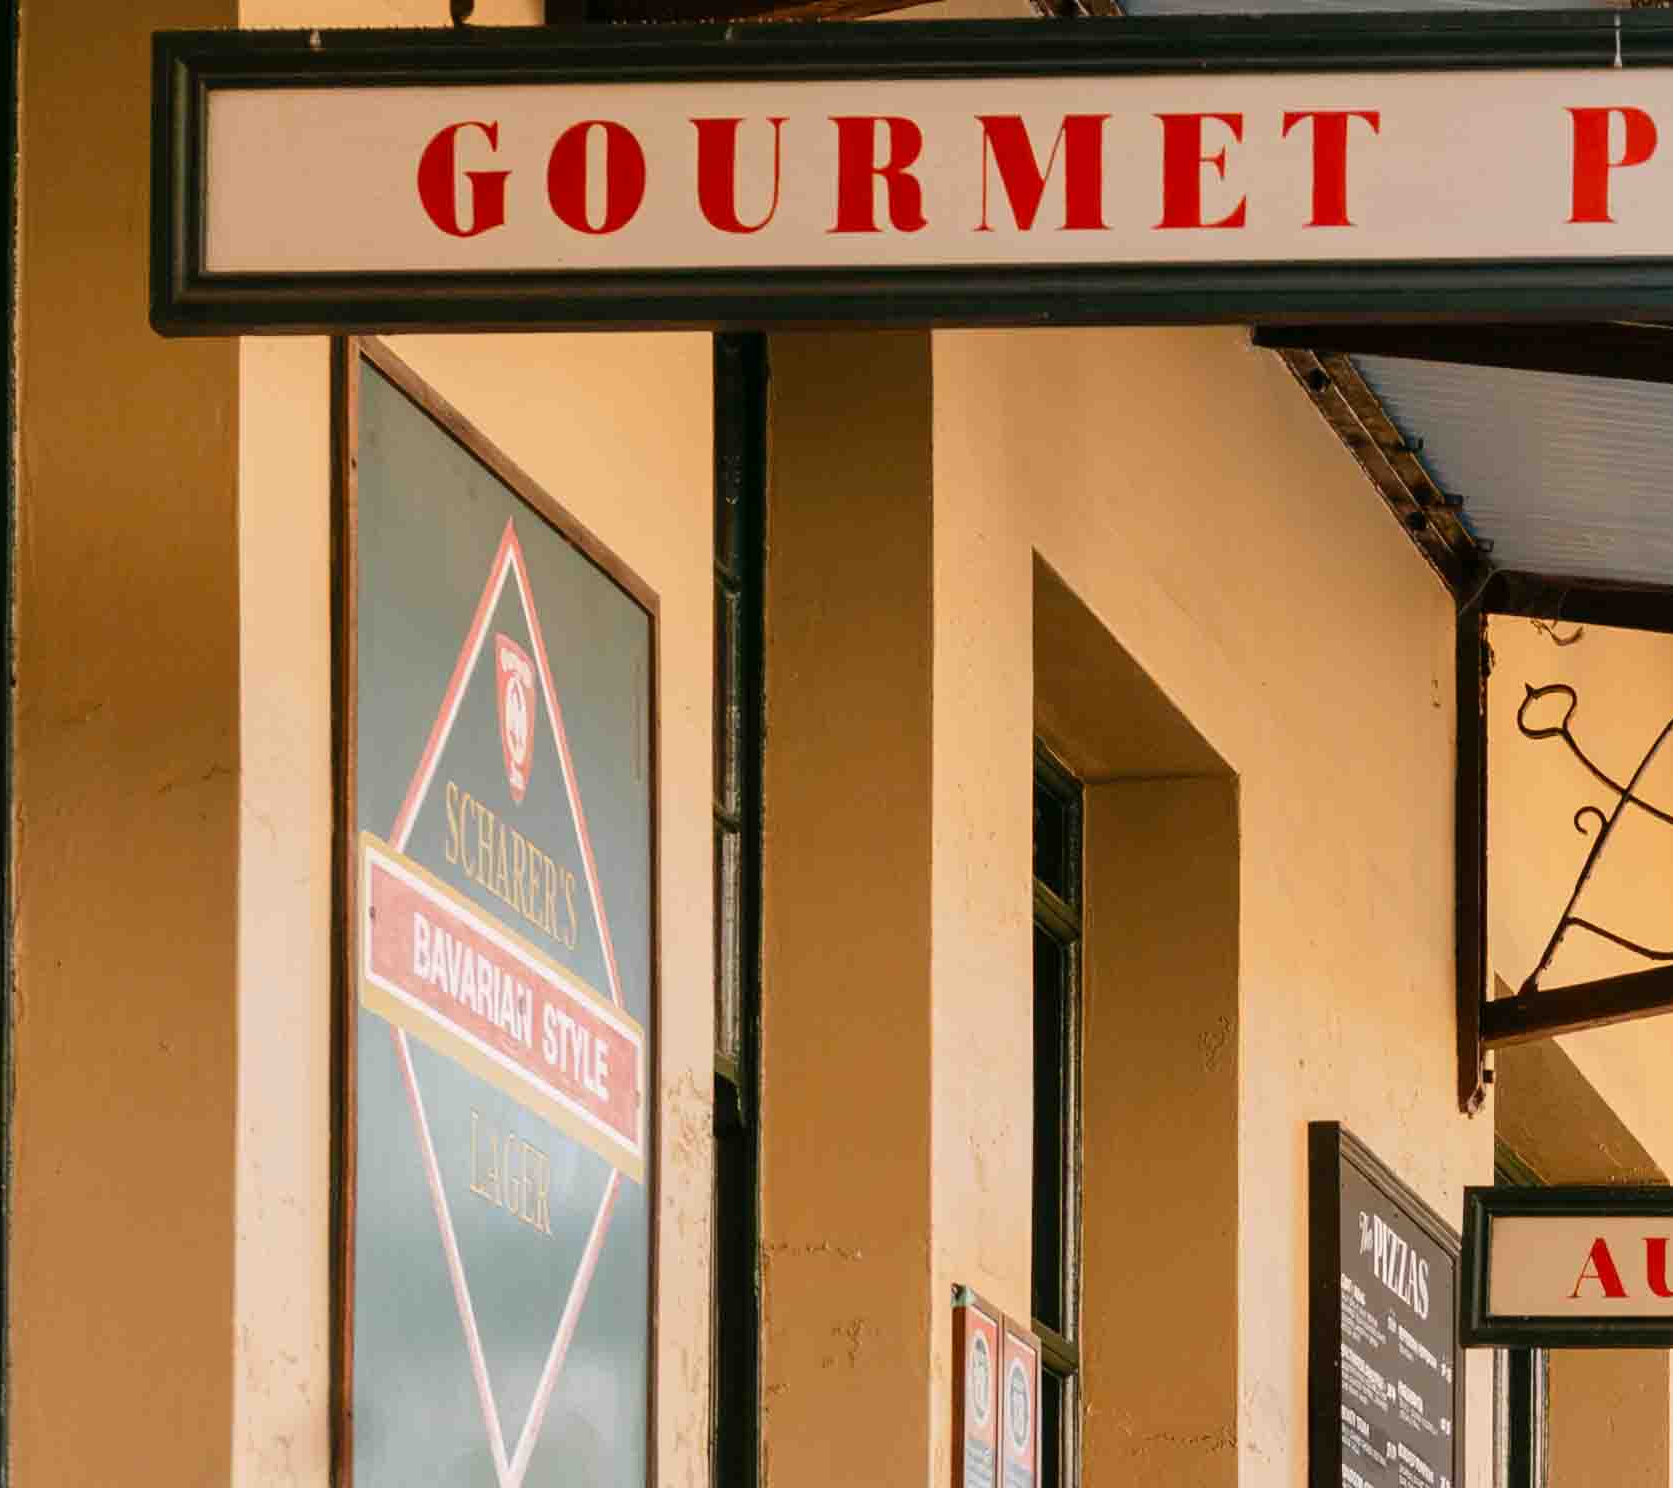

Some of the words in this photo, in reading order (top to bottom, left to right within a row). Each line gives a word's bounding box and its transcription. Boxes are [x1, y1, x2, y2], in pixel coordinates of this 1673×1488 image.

[415, 110, 1382, 239] GOURMET
[412, 911, 533, 1049] BAVARIAN
[541, 1001, 610, 1103] STYLE
[469, 1104, 554, 1238] LAGER
[1372, 1213, 1431, 1322] PIZZAS
